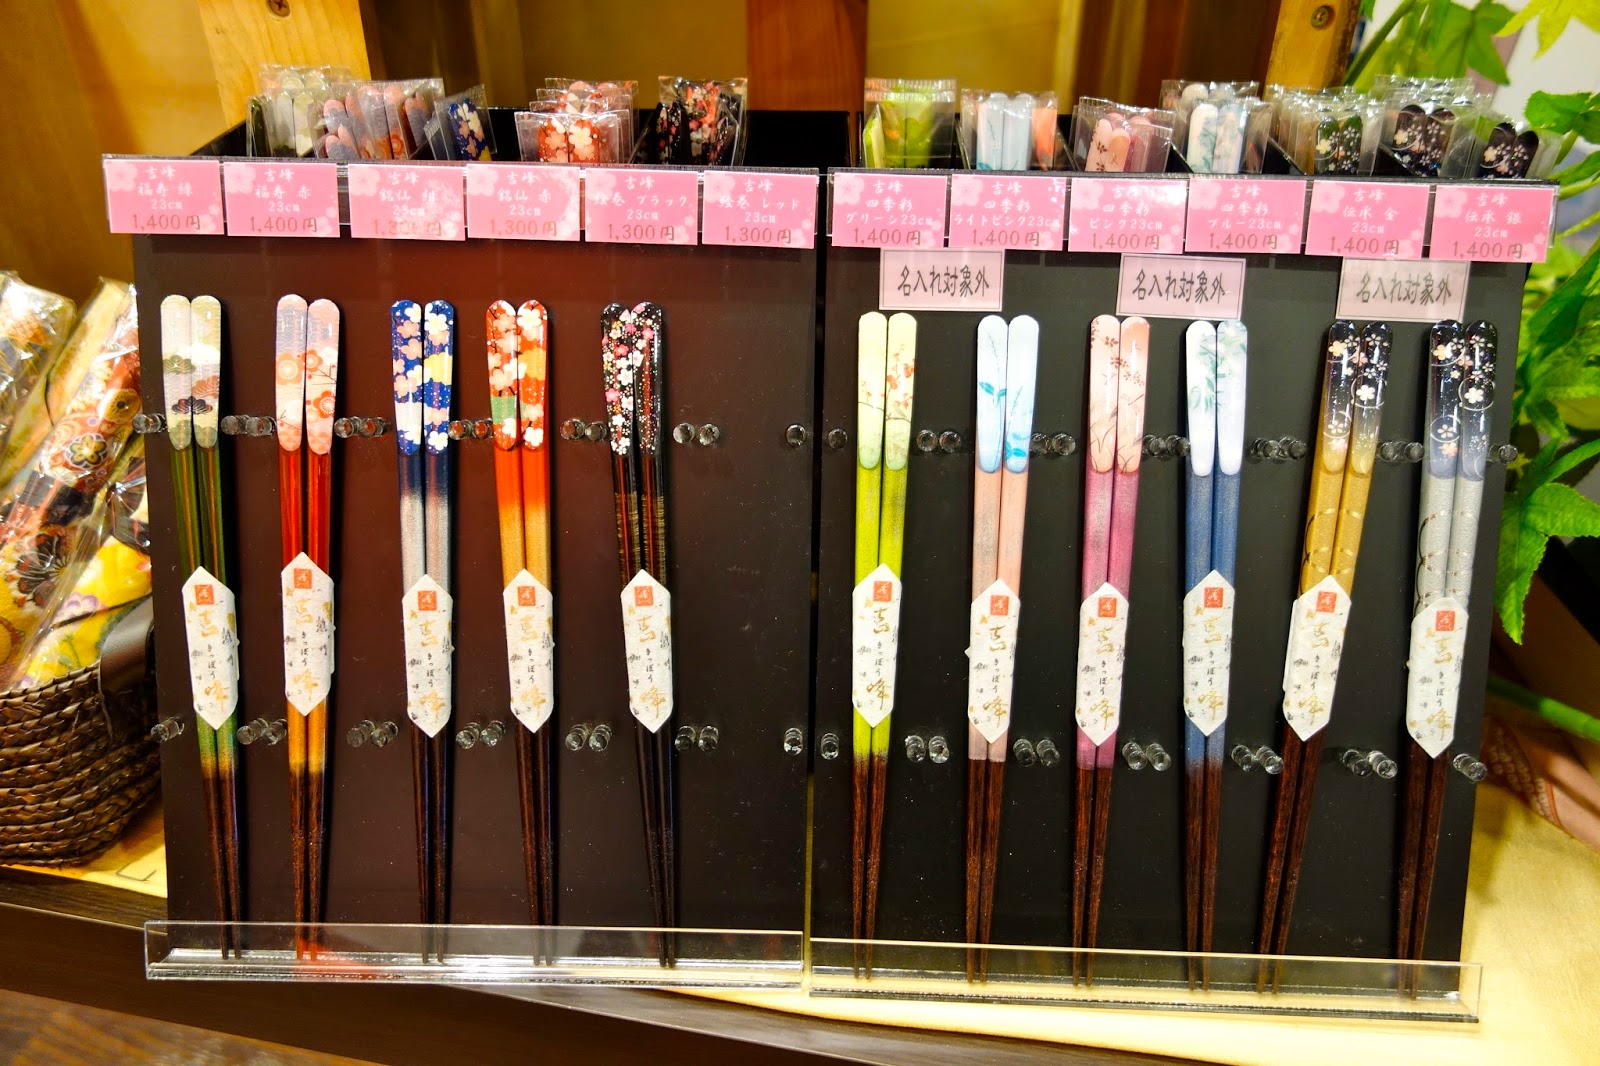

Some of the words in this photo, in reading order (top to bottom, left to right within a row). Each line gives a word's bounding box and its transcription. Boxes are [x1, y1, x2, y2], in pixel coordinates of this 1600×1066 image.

[144, 165, 177, 180] 吉峰
[263, 168, 296, 183] 吉峰
[389, 172, 419, 185] 吉峰
[506, 171, 536, 185] 吉峰
[137, 182, 167, 196] 福寿
[625, 175, 655, 190] 吉峰
[743, 179, 774, 193] 吉峰
[872, 180, 904, 195] 吉峰
[991, 181, 1024, 195] 吉峰
[255, 184, 287, 199] 福寿
[297, 186, 312, 200] 赤
[1230, 186, 1261, 200] 吉峰
[1353, 188, 1385, 203] 吉峰
[151, 198, 183, 210] 23cm
[268, 201, 300, 213] 23cm
[866, 198, 914, 213] 四季彩
[983, 199, 1032, 213] 四季彩
[1476, 193, 1509, 208] 吉峰
[509, 204, 541, 217] 23cm
[627, 209, 660, 221] 23cm
[1102, 202, 1151, 217] 四季彩
[1220, 202, 1270, 216] 四季彩
[1343, 205, 1374, 219] 伝承
[131, 214, 201, 231] 1,400円
[249, 216, 318, 233] 1,400円
[744, 211, 777, 224] 23cm
[1464, 210, 1496, 224] 伝承
[489, 218, 558, 236] 1,300円
[607, 224, 676, 242] 1,300円
[1351, 222, 1385, 234] 23cm
[1474, 226, 1508, 238] 23cm
[724, 226, 793, 244] 1,300円
[853, 228, 921, 246] 1,400円
[971, 231, 1041, 247] 1,400円
[1091, 233, 1160, 250] 1,400円
[1208, 233, 1279, 251] 1,400円
[1330, 236, 1400, 254] 1,400円
[1452, 241, 1523, 260] 1,400円
[897, 265, 989, 298] 名入れ対象外
[1131, 267, 1226, 306] 名入れ対象外
[1356, 271, 1452, 307] 名入れ対象外
